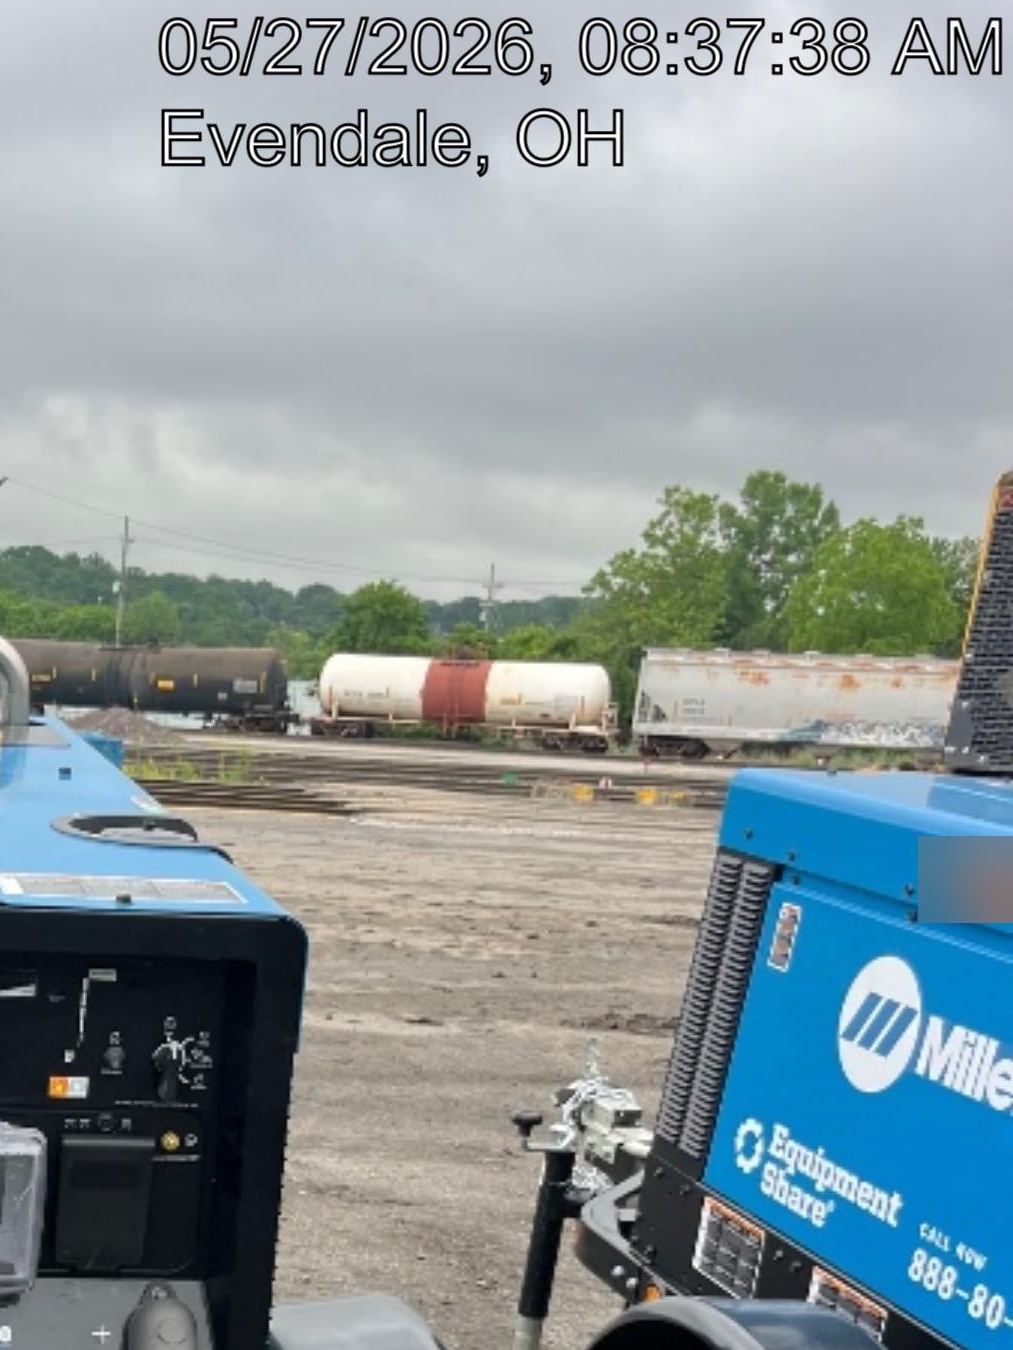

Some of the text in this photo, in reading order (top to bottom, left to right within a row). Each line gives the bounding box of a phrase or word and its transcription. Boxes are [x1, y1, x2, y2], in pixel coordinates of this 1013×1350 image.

[914, 1015, 1013, 1117] Mille
[760, 1161, 827, 1228] Share
[768, 1124, 904, 1227] Equipment
[919, 1222, 988, 1271] CALL NOW
